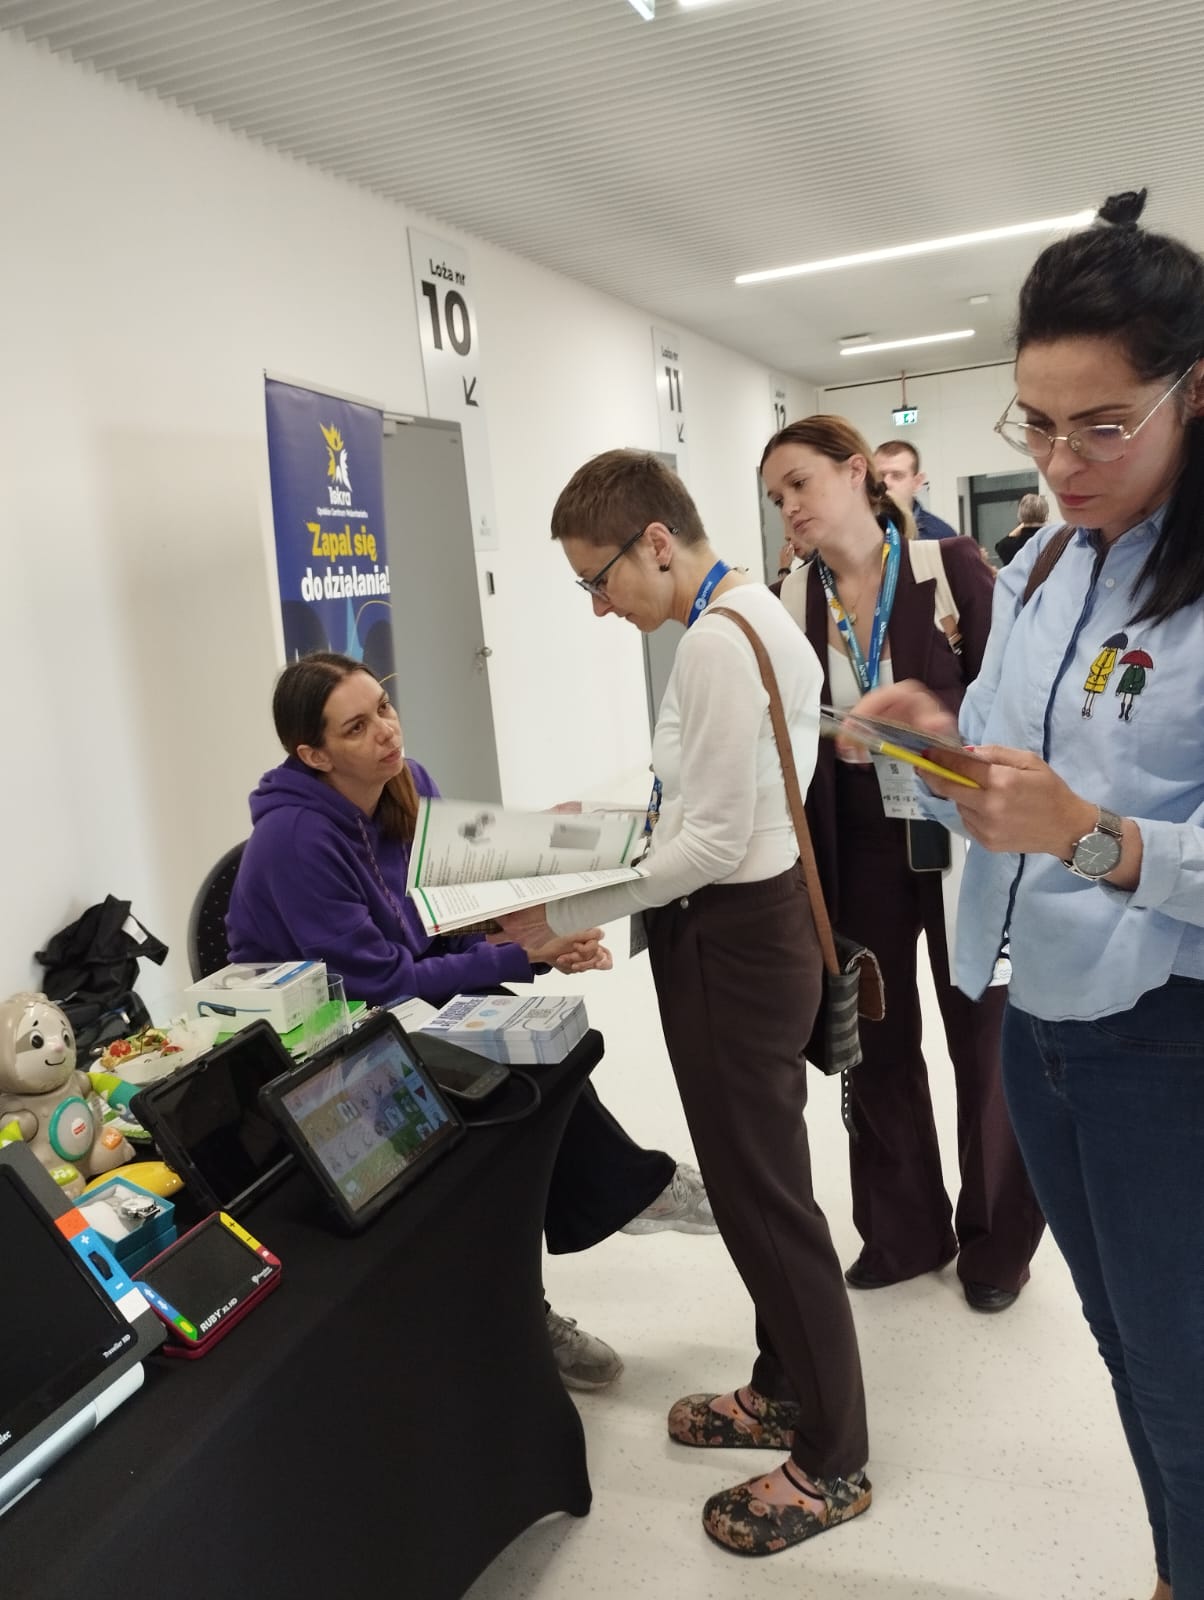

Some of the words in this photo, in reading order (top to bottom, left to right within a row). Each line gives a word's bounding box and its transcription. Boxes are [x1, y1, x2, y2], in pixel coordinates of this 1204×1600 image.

[429, 258, 454, 281] Loża
[455, 272, 466, 286] nr
[421, 280, 472, 357] 10
[665, 366, 682, 413] 11
[306, 521, 353, 562] Zapal
[353, 525, 378, 562] się
[301, 567, 323, 602] do
[323, 565, 391, 600] działania!
[200, 1308, 221, 1333] RUBY
